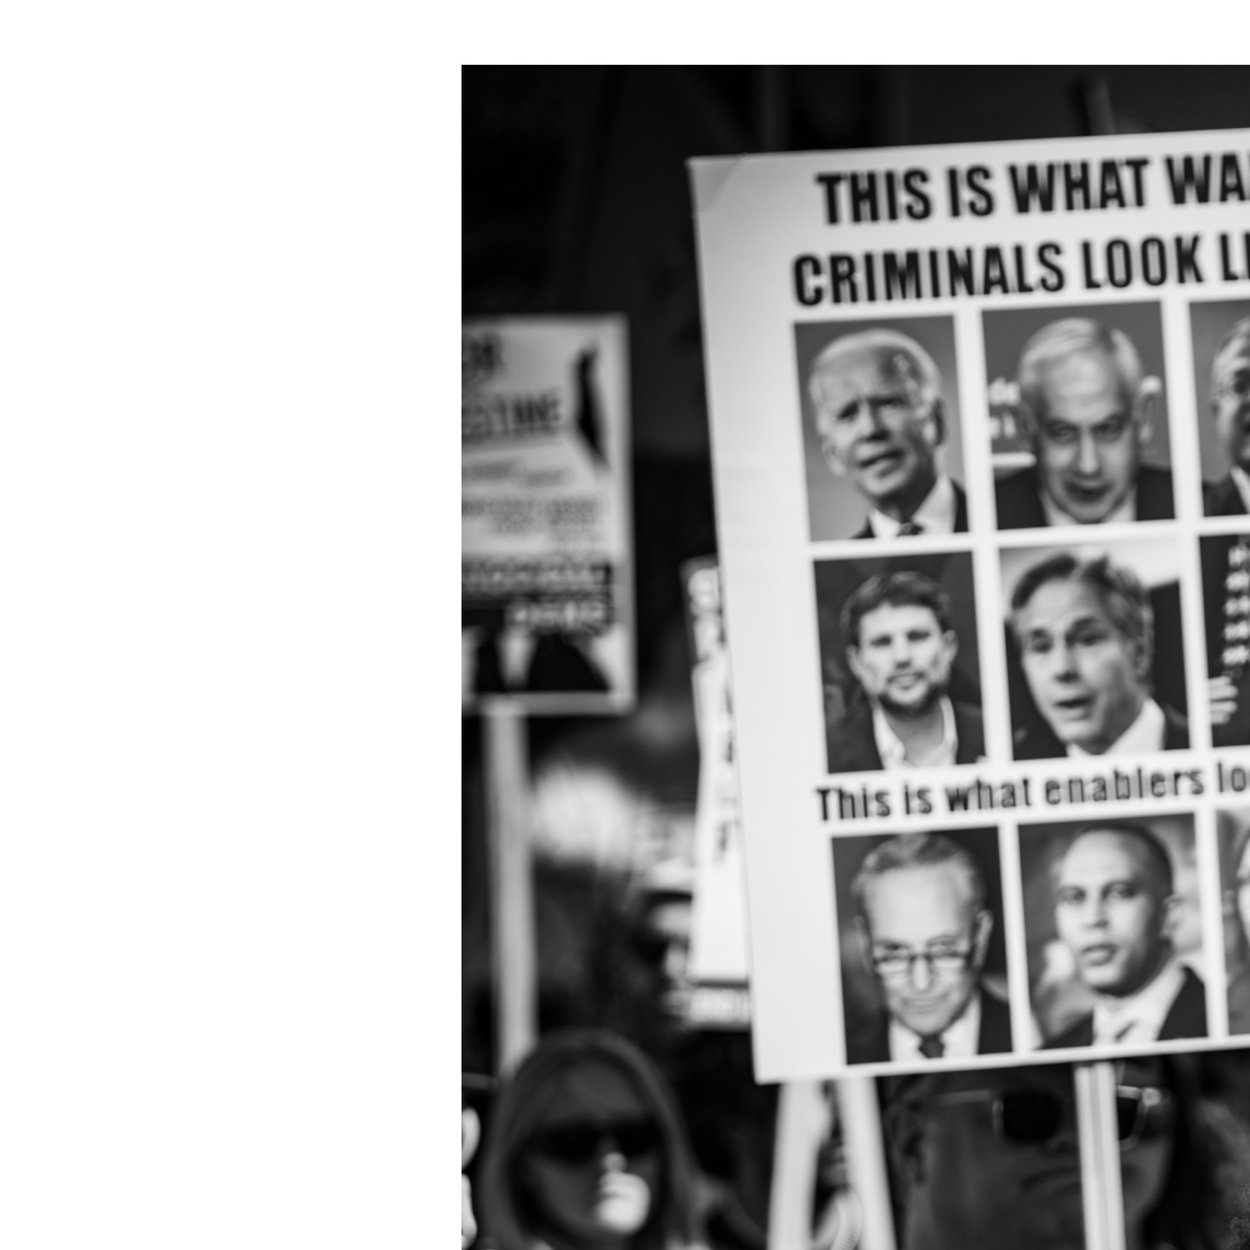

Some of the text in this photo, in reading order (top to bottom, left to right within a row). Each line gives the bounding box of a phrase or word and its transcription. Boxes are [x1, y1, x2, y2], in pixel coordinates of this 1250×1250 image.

[814, 168, 932, 225] THIS
[946, 165, 995, 219] IS
[1007, 157, 1150, 214] WHAT
[791, 241, 1066, 306] CRIMINALS
[1081, 234, 1204, 291] LOOK
[816, 785, 890, 821] This
[903, 781, 932, 815] is
[944, 776, 1032, 812] what
[1044, 766, 1204, 806] enablers
